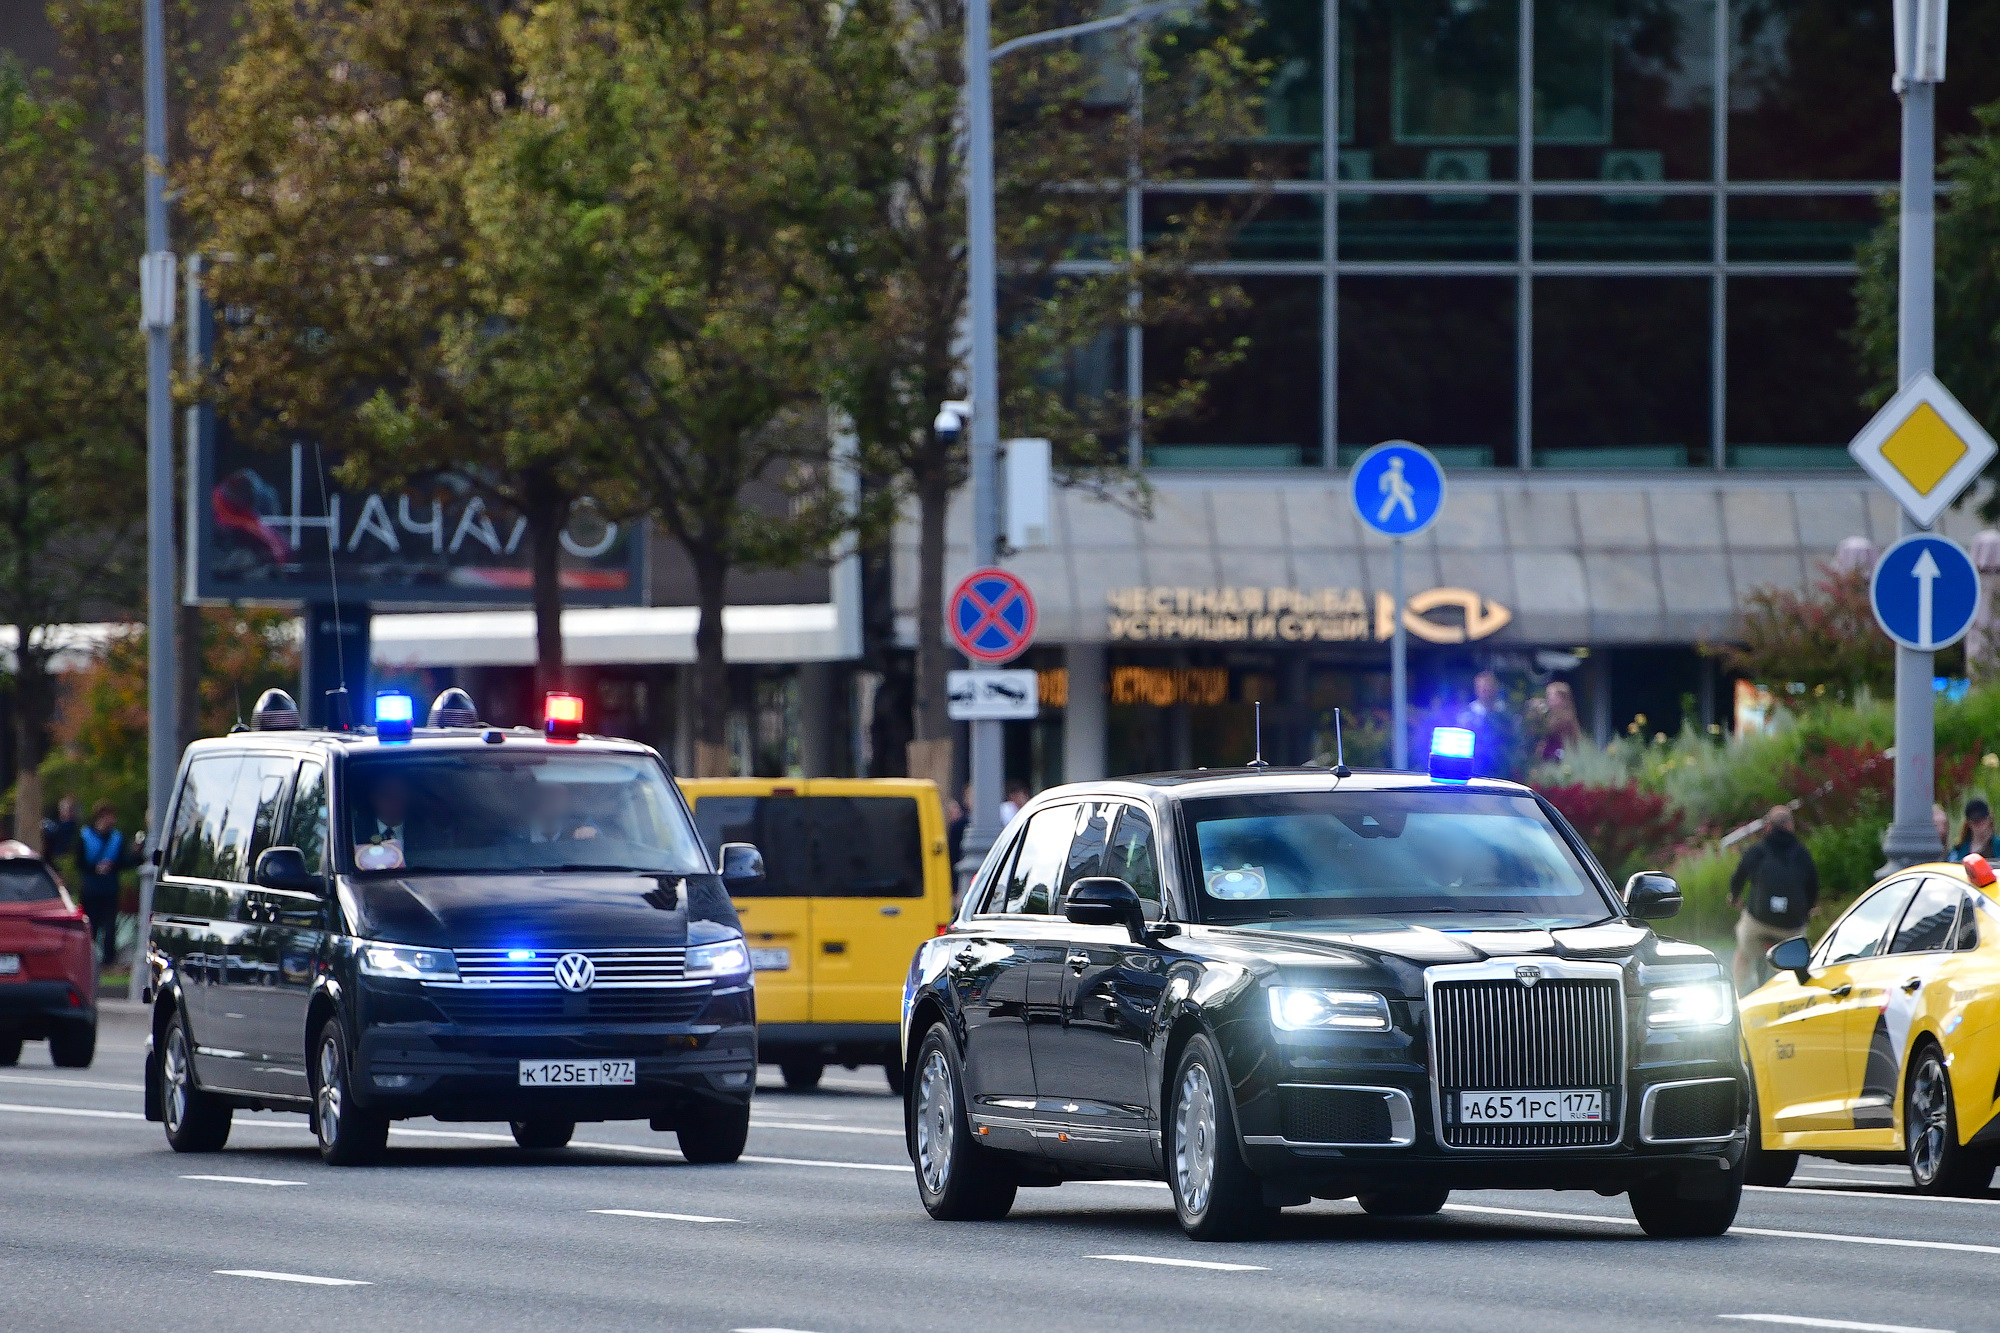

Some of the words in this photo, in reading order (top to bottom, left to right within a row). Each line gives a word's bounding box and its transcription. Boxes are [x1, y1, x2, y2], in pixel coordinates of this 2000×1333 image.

[1108, 587, 1263, 612] ЧЕСТНАЯ
[1107, 617, 1248, 640] УСТРИЦЫ
[1252, 617, 1276, 640] И
[1279, 617, 1368, 640] СУШИ
[603, 1063, 630, 1076] 977
[1470, 1096, 1557, 1118] А651РС
[1563, 1094, 1595, 1111] 177
